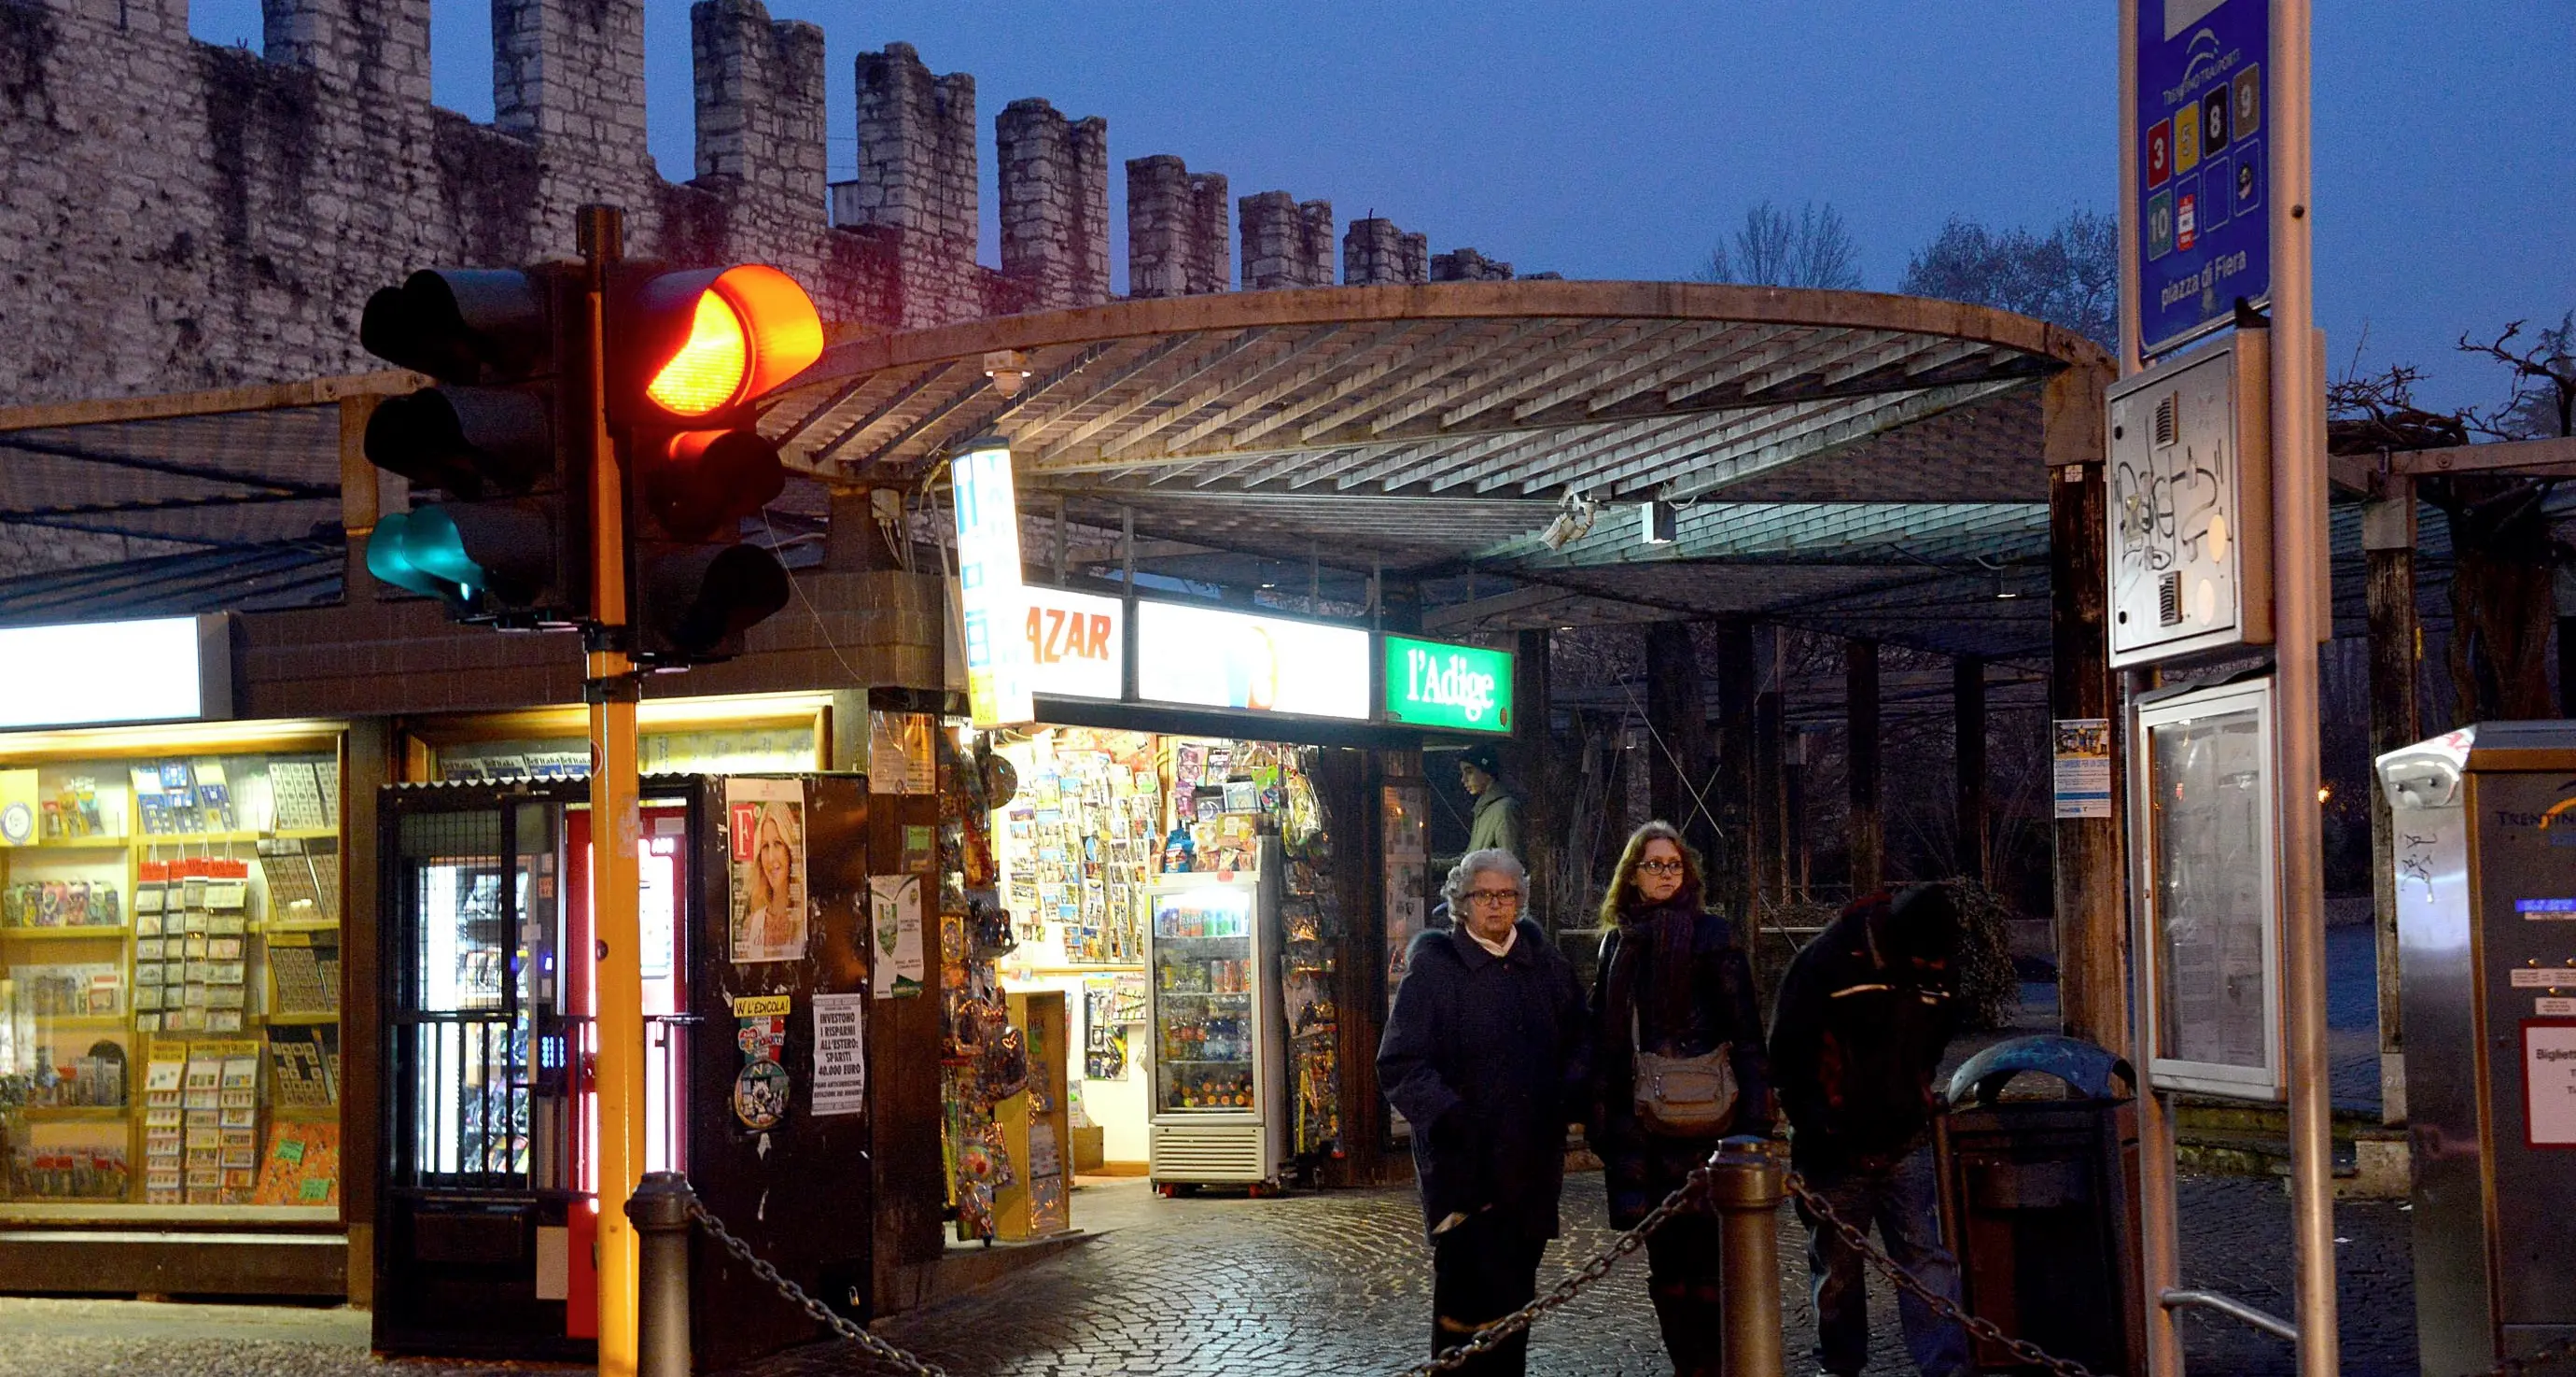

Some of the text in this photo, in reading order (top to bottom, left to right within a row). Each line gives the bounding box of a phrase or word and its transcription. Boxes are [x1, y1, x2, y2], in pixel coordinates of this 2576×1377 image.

[2153, 84, 2251, 169] 3 5 8 9
[2150, 207, 2168, 242] 10
[2162, 250, 2247, 313] piazza di Fiera
[1406, 647, 1495, 722] l'Adige
[735, 808, 753, 856] F
[735, 997, 789, 1015] W L'EDICOLA!
[819, 1012, 856, 1025] INVESTONO
[824, 1025, 856, 1037] RISPARMI
[820, 1038, 859, 1050] ALL'ESTERO:
[825, 1051, 852, 1062] SPARITI
[819, 1063, 861, 1076] 40.000 EURO
